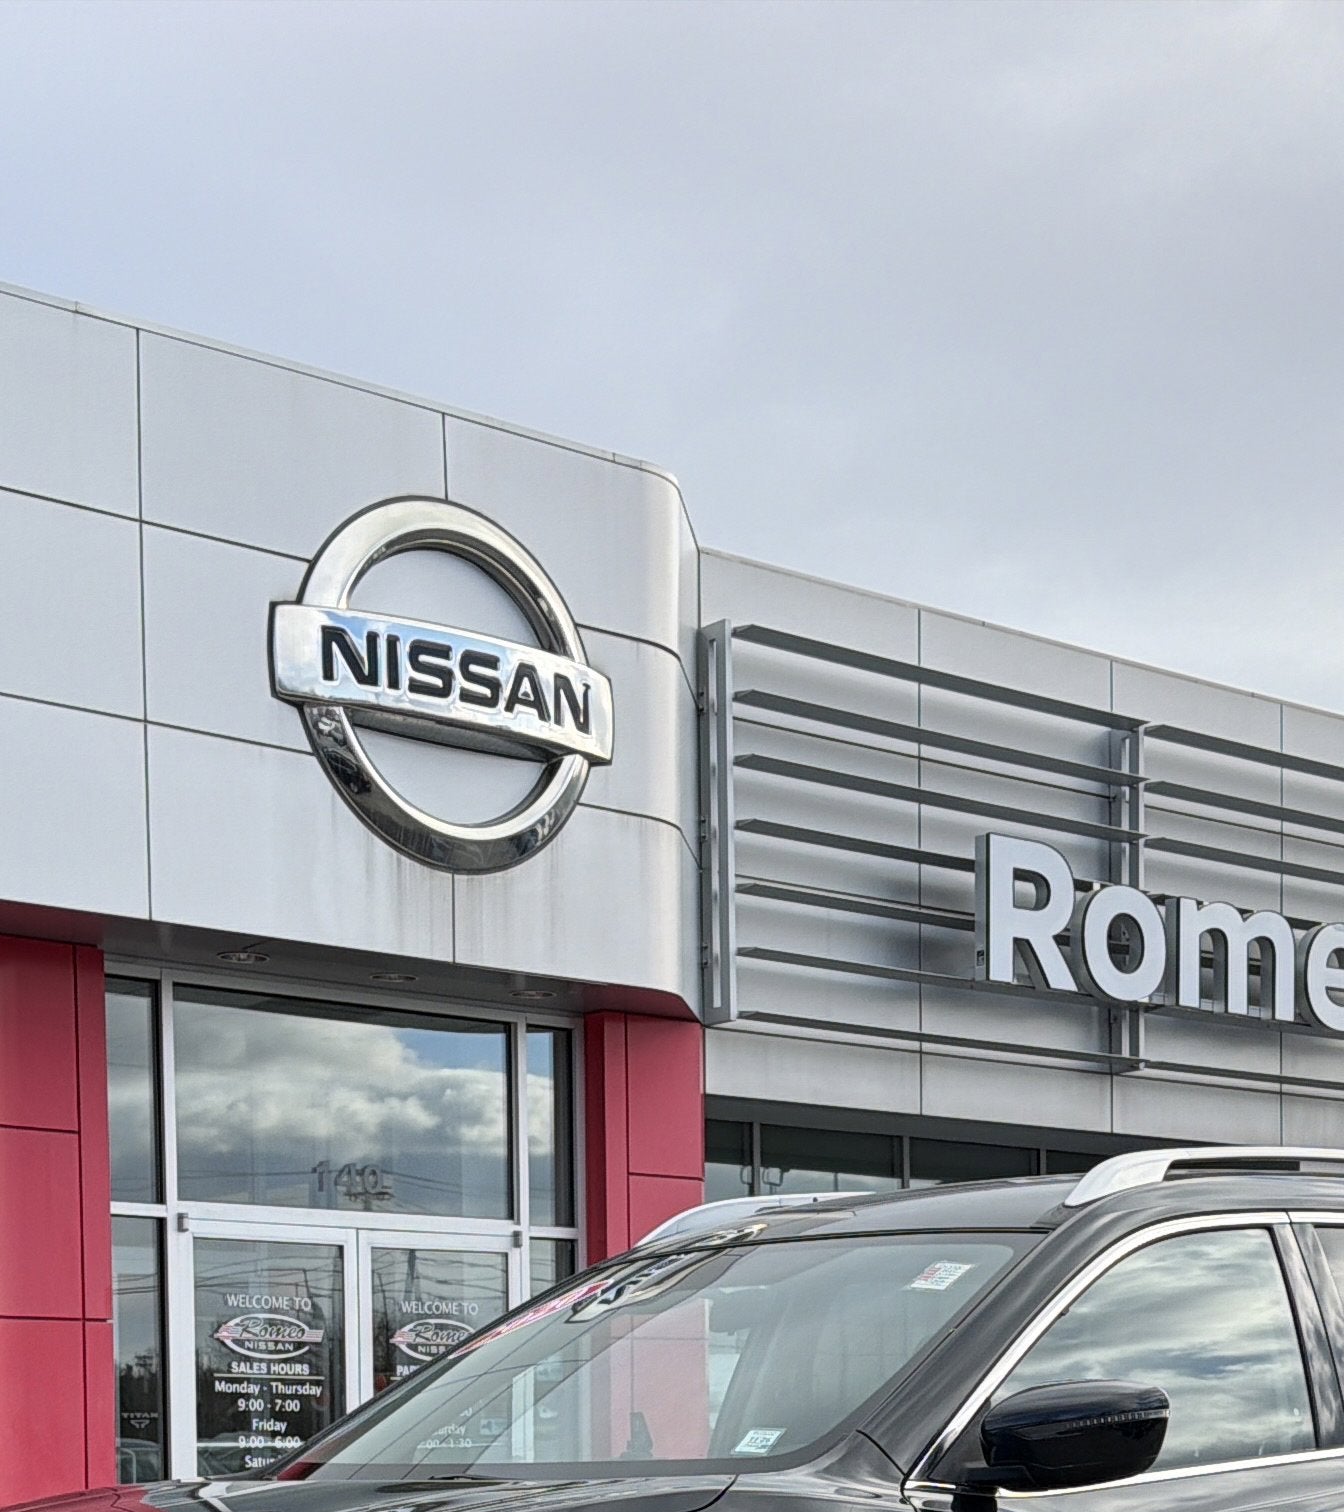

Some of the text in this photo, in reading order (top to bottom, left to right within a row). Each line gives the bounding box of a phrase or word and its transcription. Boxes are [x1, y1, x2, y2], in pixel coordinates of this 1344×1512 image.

[321, 624, 592, 736] NISSAN
[226, 1293, 312, 1312] WELCOME TO
[401, 1301, 479, 1316] WELCOME TO
[239, 1316, 306, 1340] Romeo
[412, 1321, 471, 1342] Rome
[244, 1341, 294, 1352] NISSAN
[417, 1345, 447, 1354] NISS
[231, 1361, 310, 1376] SALES HOURS
[214, 1380, 261, 1396] Monday
[269, 1381, 323, 1398] Thursday
[237, 1398, 265, 1412] 9:00
[274, 1399, 301, 1412] 7:00
[252, 1418, 288, 1433] Friday
